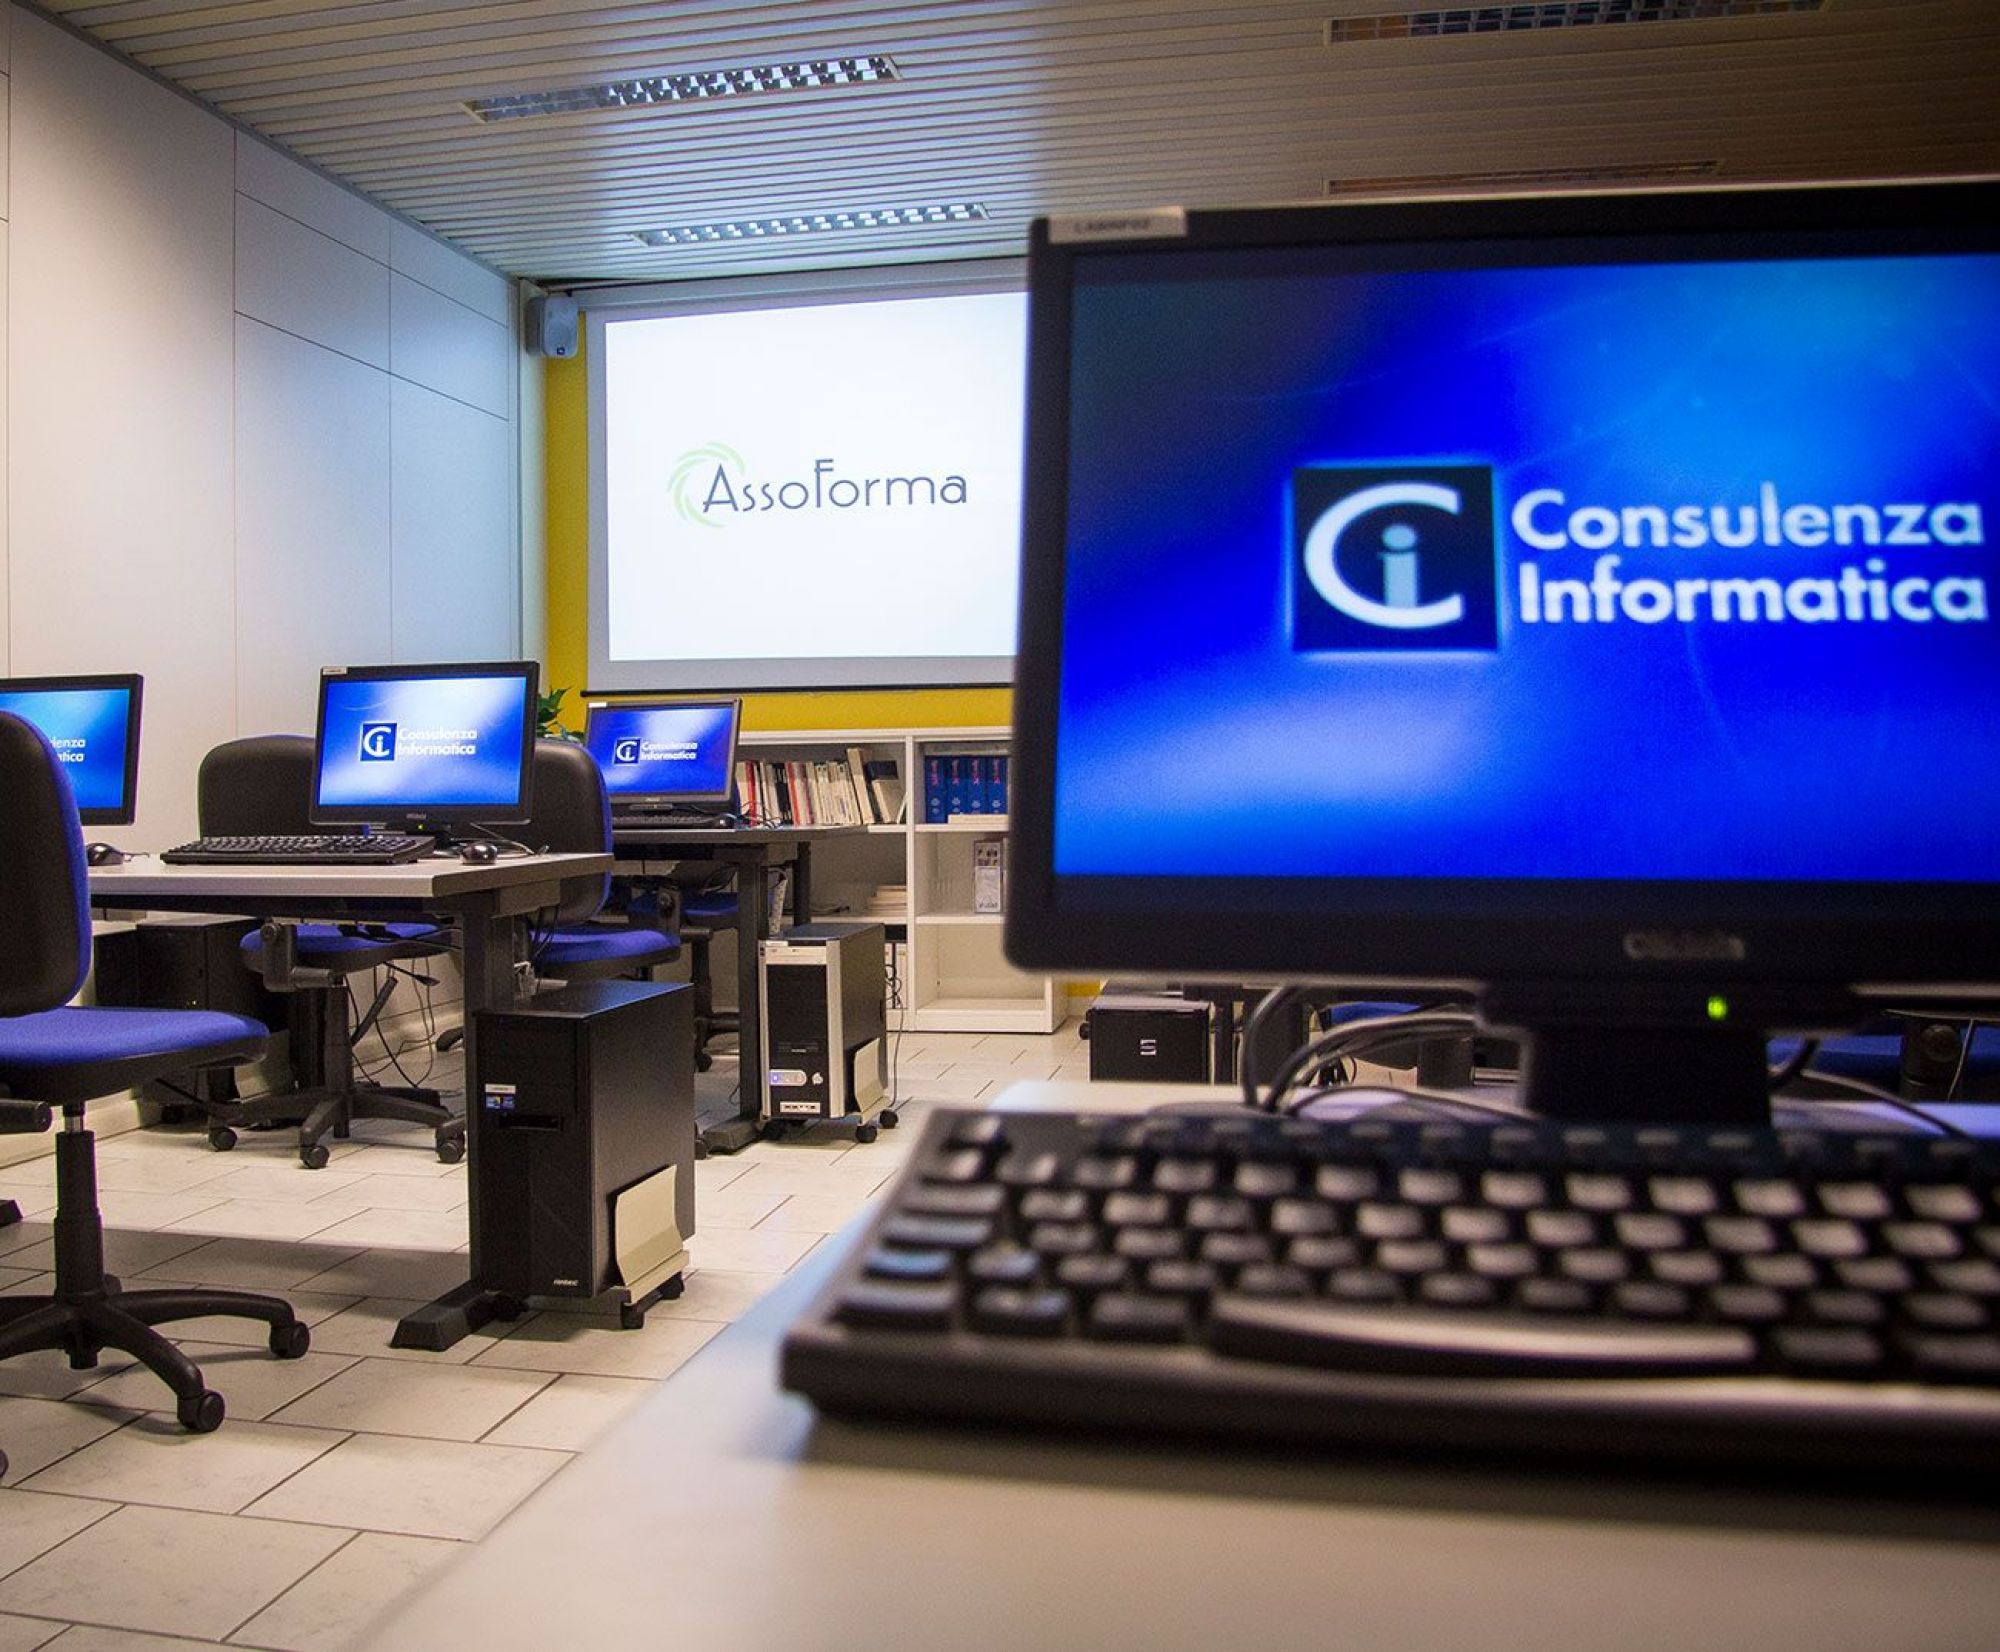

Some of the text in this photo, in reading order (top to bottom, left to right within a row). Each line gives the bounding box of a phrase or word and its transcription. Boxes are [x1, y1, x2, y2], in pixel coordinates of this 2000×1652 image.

[702, 458, 967, 513] AssoForma
[1511, 480, 1984, 550] Consulenza
[1518, 554, 1988, 624] Informatica
[51, 737, 86, 748] lenza
[398, 742, 476, 756] Informatica
[399, 728, 477, 741] Consulenza
